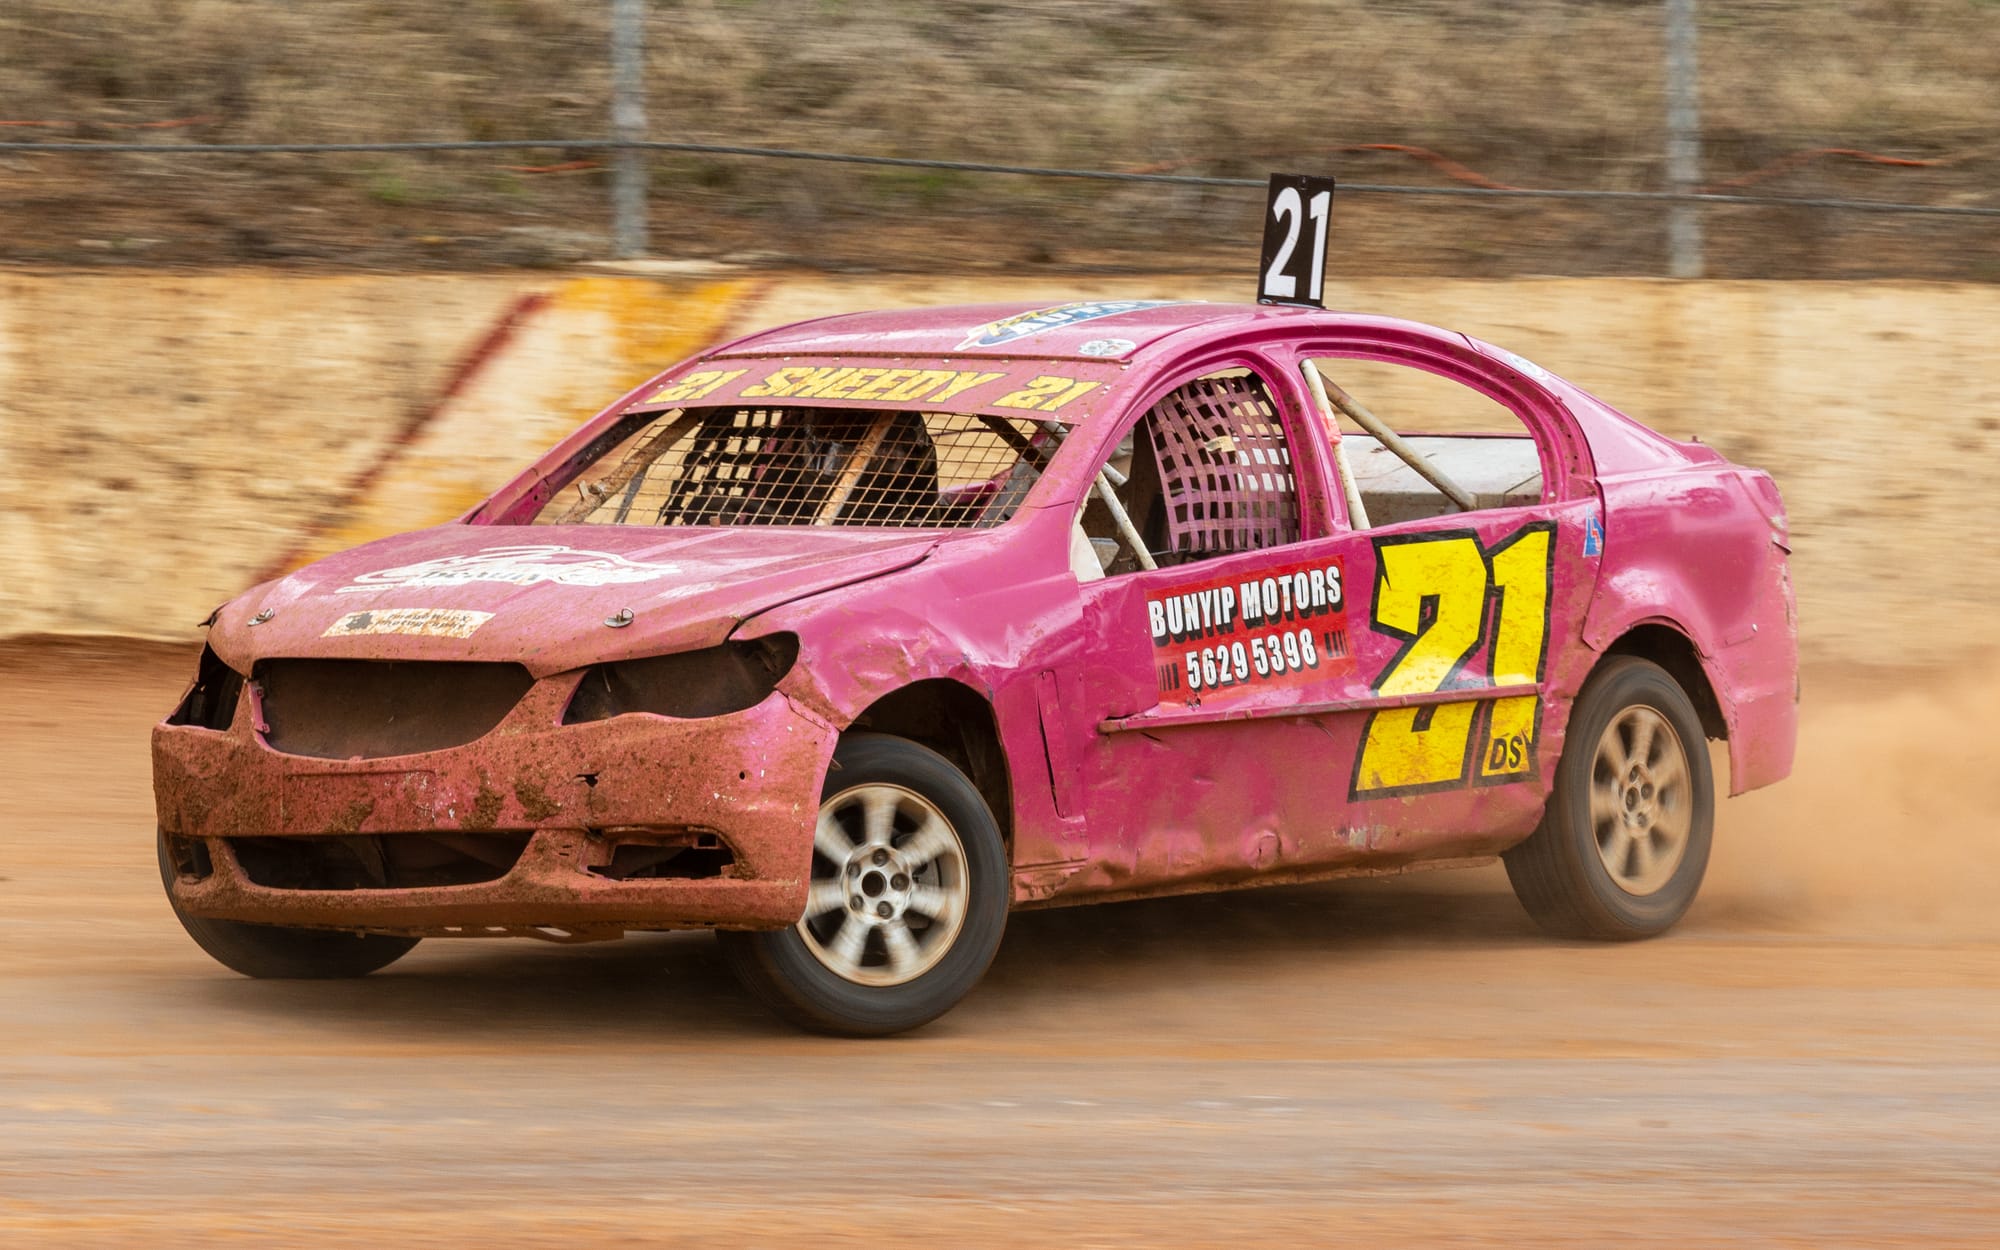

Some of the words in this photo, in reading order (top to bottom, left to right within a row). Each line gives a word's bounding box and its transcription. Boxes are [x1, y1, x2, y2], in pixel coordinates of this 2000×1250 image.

[1264, 187, 1331, 300] 21
[644, 367, 749, 405] 21
[738, 366, 1009, 405] SHEEDY
[991, 374, 1104, 412] 21
[1148, 586, 1238, 644] BUNYIP
[1240, 566, 1344, 626] MOTORS
[1186, 642, 1249, 690] 5629
[1251, 628, 1318, 676] 5398
[1349, 521, 1557, 801] 21
[1488, 736, 1524, 771] DS
